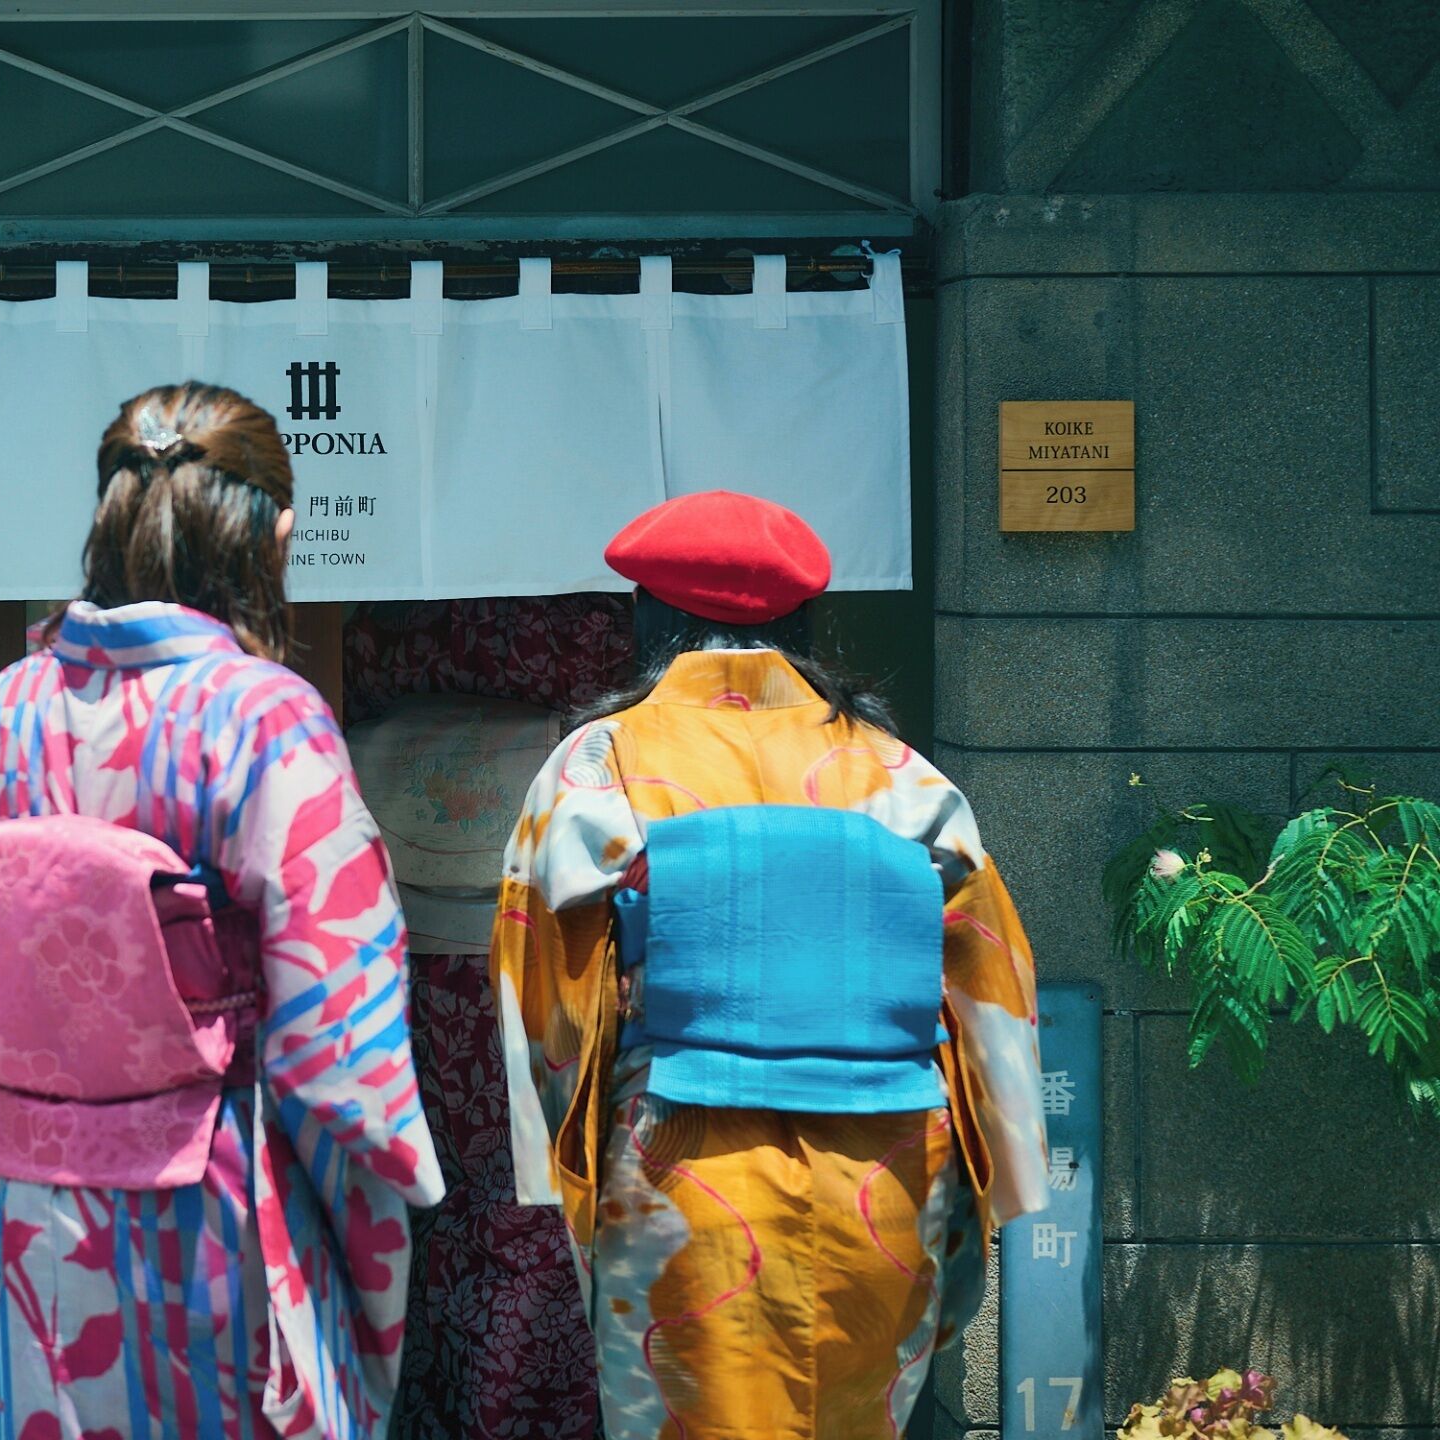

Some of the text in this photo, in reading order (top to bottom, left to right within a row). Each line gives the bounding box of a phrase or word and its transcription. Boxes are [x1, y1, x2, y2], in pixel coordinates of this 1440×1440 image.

[1044, 421, 1094, 436] KOIKE
[280, 432, 388, 455] PPONIA
[1028, 445, 1110, 460] MIYATANI
[1046, 486, 1087, 504] 203
[309, 495, 377, 517] 門前町
[290, 529, 350, 542] HICHIBU
[287, 553, 366, 566] INE TOWN
[1016, 1377, 1084, 1432] 17
